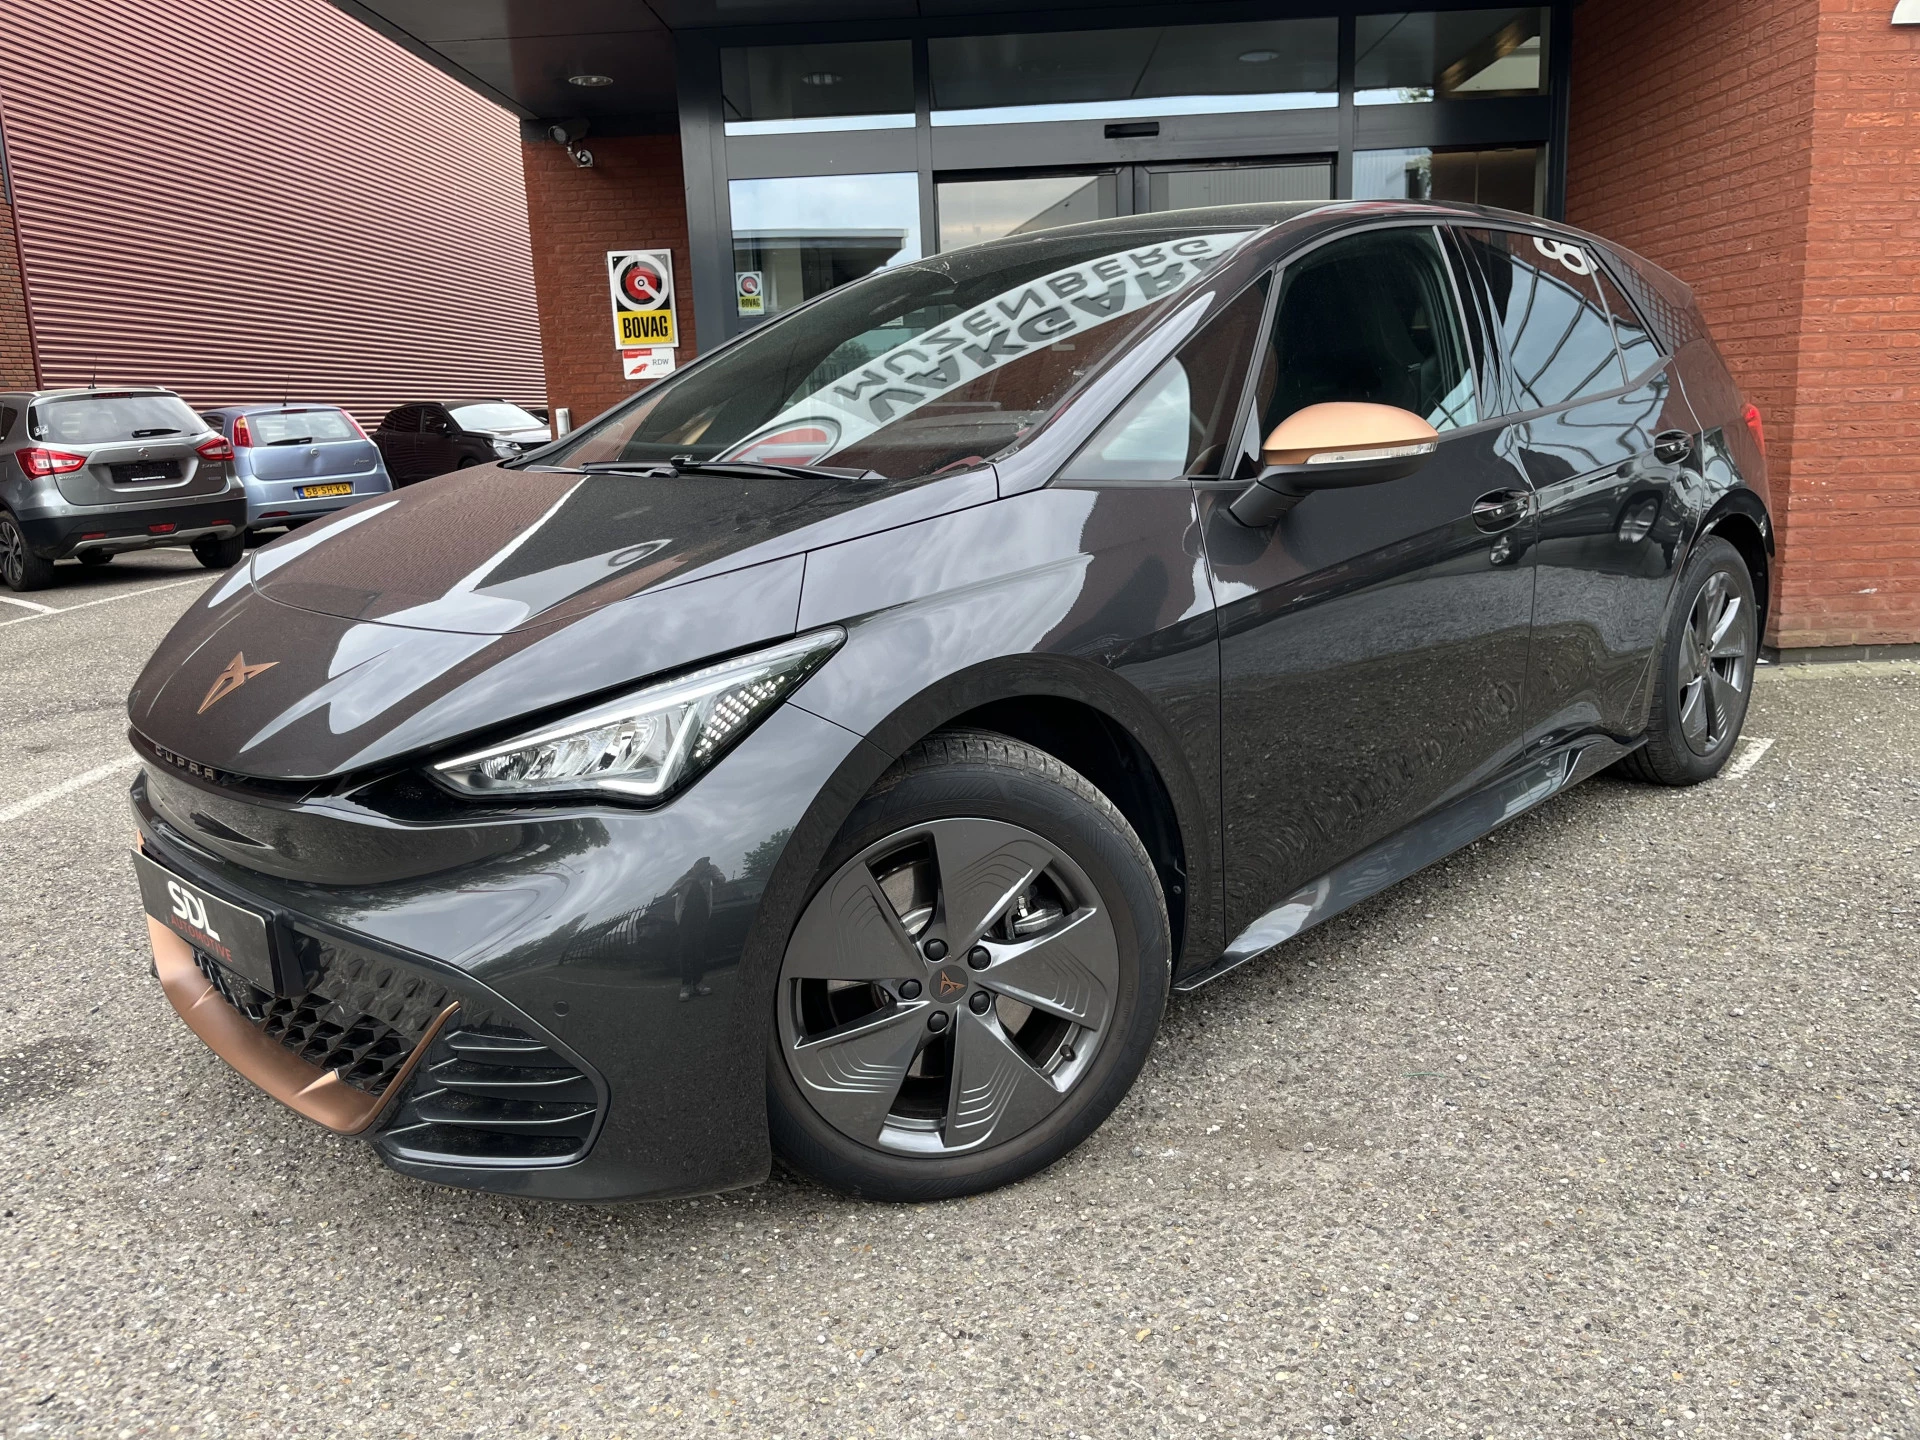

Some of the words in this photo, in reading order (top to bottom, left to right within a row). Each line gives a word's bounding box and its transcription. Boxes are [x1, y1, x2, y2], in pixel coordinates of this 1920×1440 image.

[741, 298, 761, 308] BOVAG
[622, 315, 669, 339] BOVAG
[305, 484, 348, 496] 58-SH-KR
[155, 744, 214, 780] CUPRA
[167, 880, 221, 942] SDL
[171, 914, 233, 963] AUTOMOTIVE
